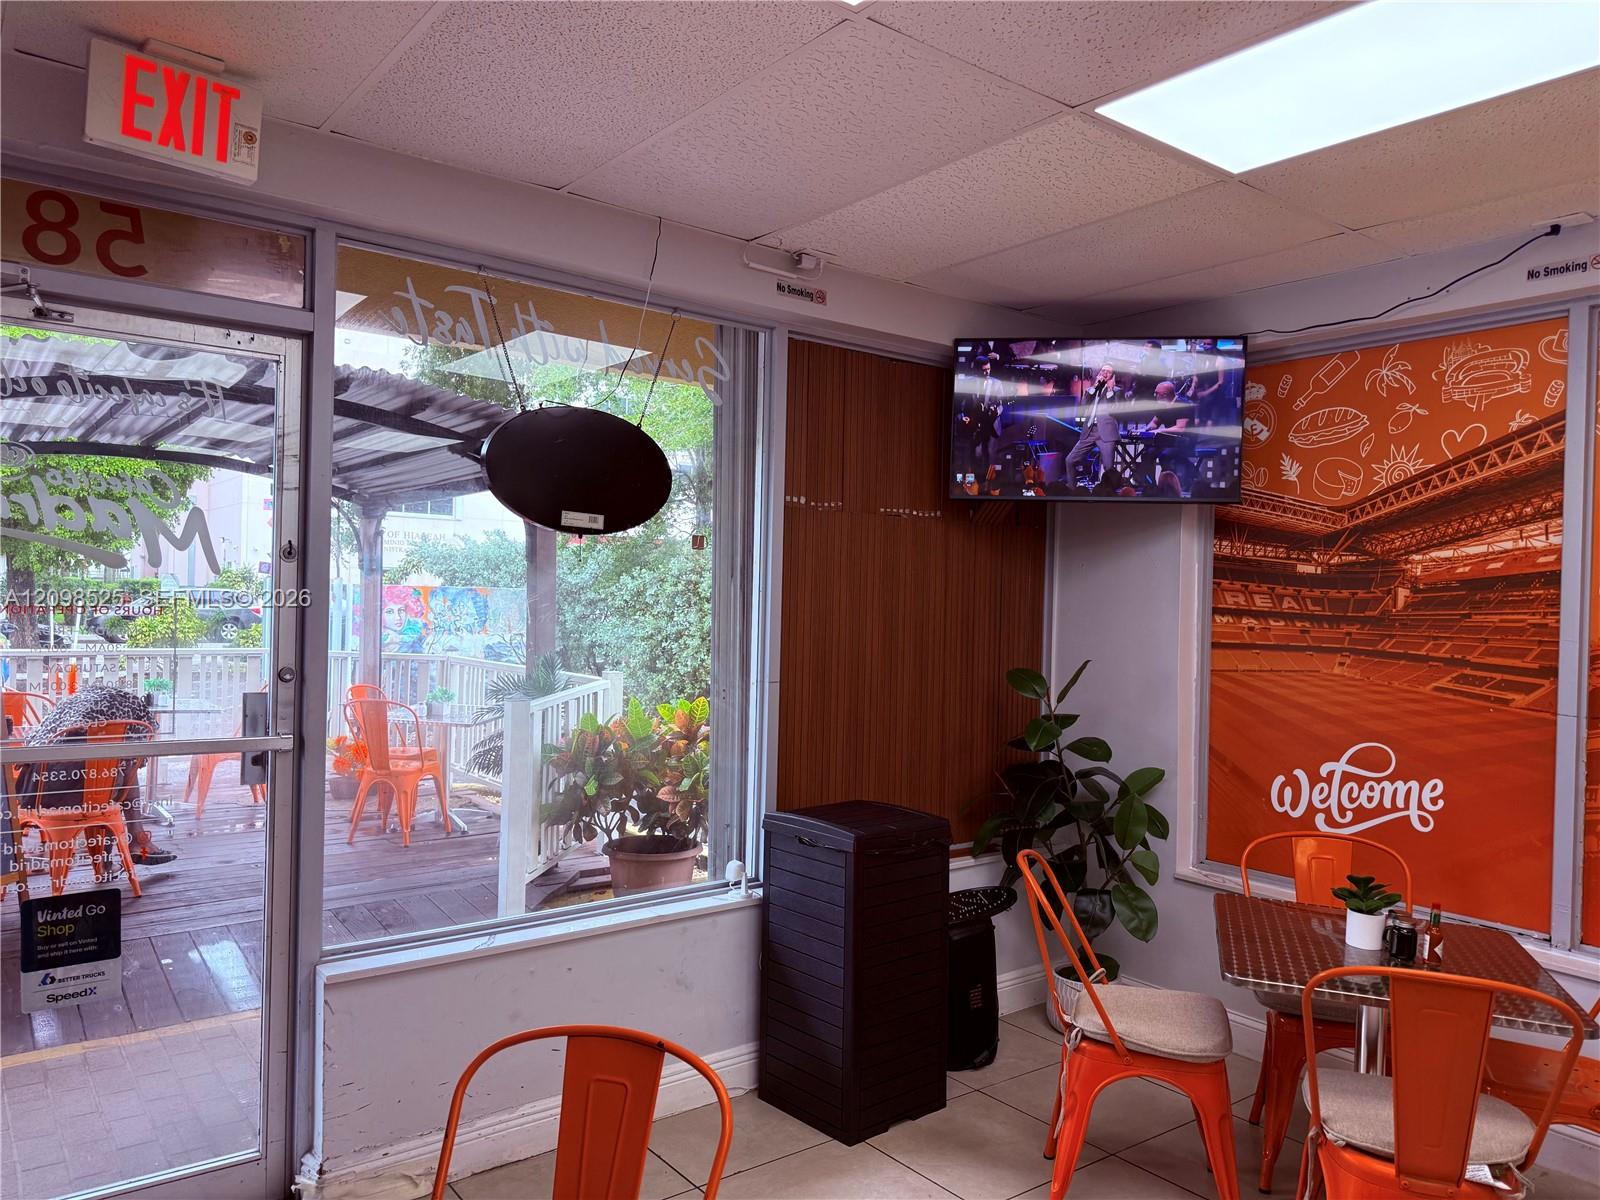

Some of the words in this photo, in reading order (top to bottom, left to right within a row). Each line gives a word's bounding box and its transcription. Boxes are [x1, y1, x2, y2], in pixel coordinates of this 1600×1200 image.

[121, 54, 240, 164] EXIT
[1527, 270, 1541, 280] No
[1543, 261, 1588, 278] Smoking
[777, 282, 786, 293] No
[787, 285, 814, 301] Smoking
[387, 530, 400, 538] OF
[1223, 590, 1325, 612] REAL
[1214, 613, 1362, 630] MADRID
[1271, 742, 1445, 835] Welcome
[37, 904, 83, 923] Vinted
[85, 904, 106, 916] Go
[37, 924, 75, 937] Shop
[57, 976, 81, 984] BETTER
[82, 971, 106, 980] TRUCKS
[46, 987, 97, 1004] SpeedX
